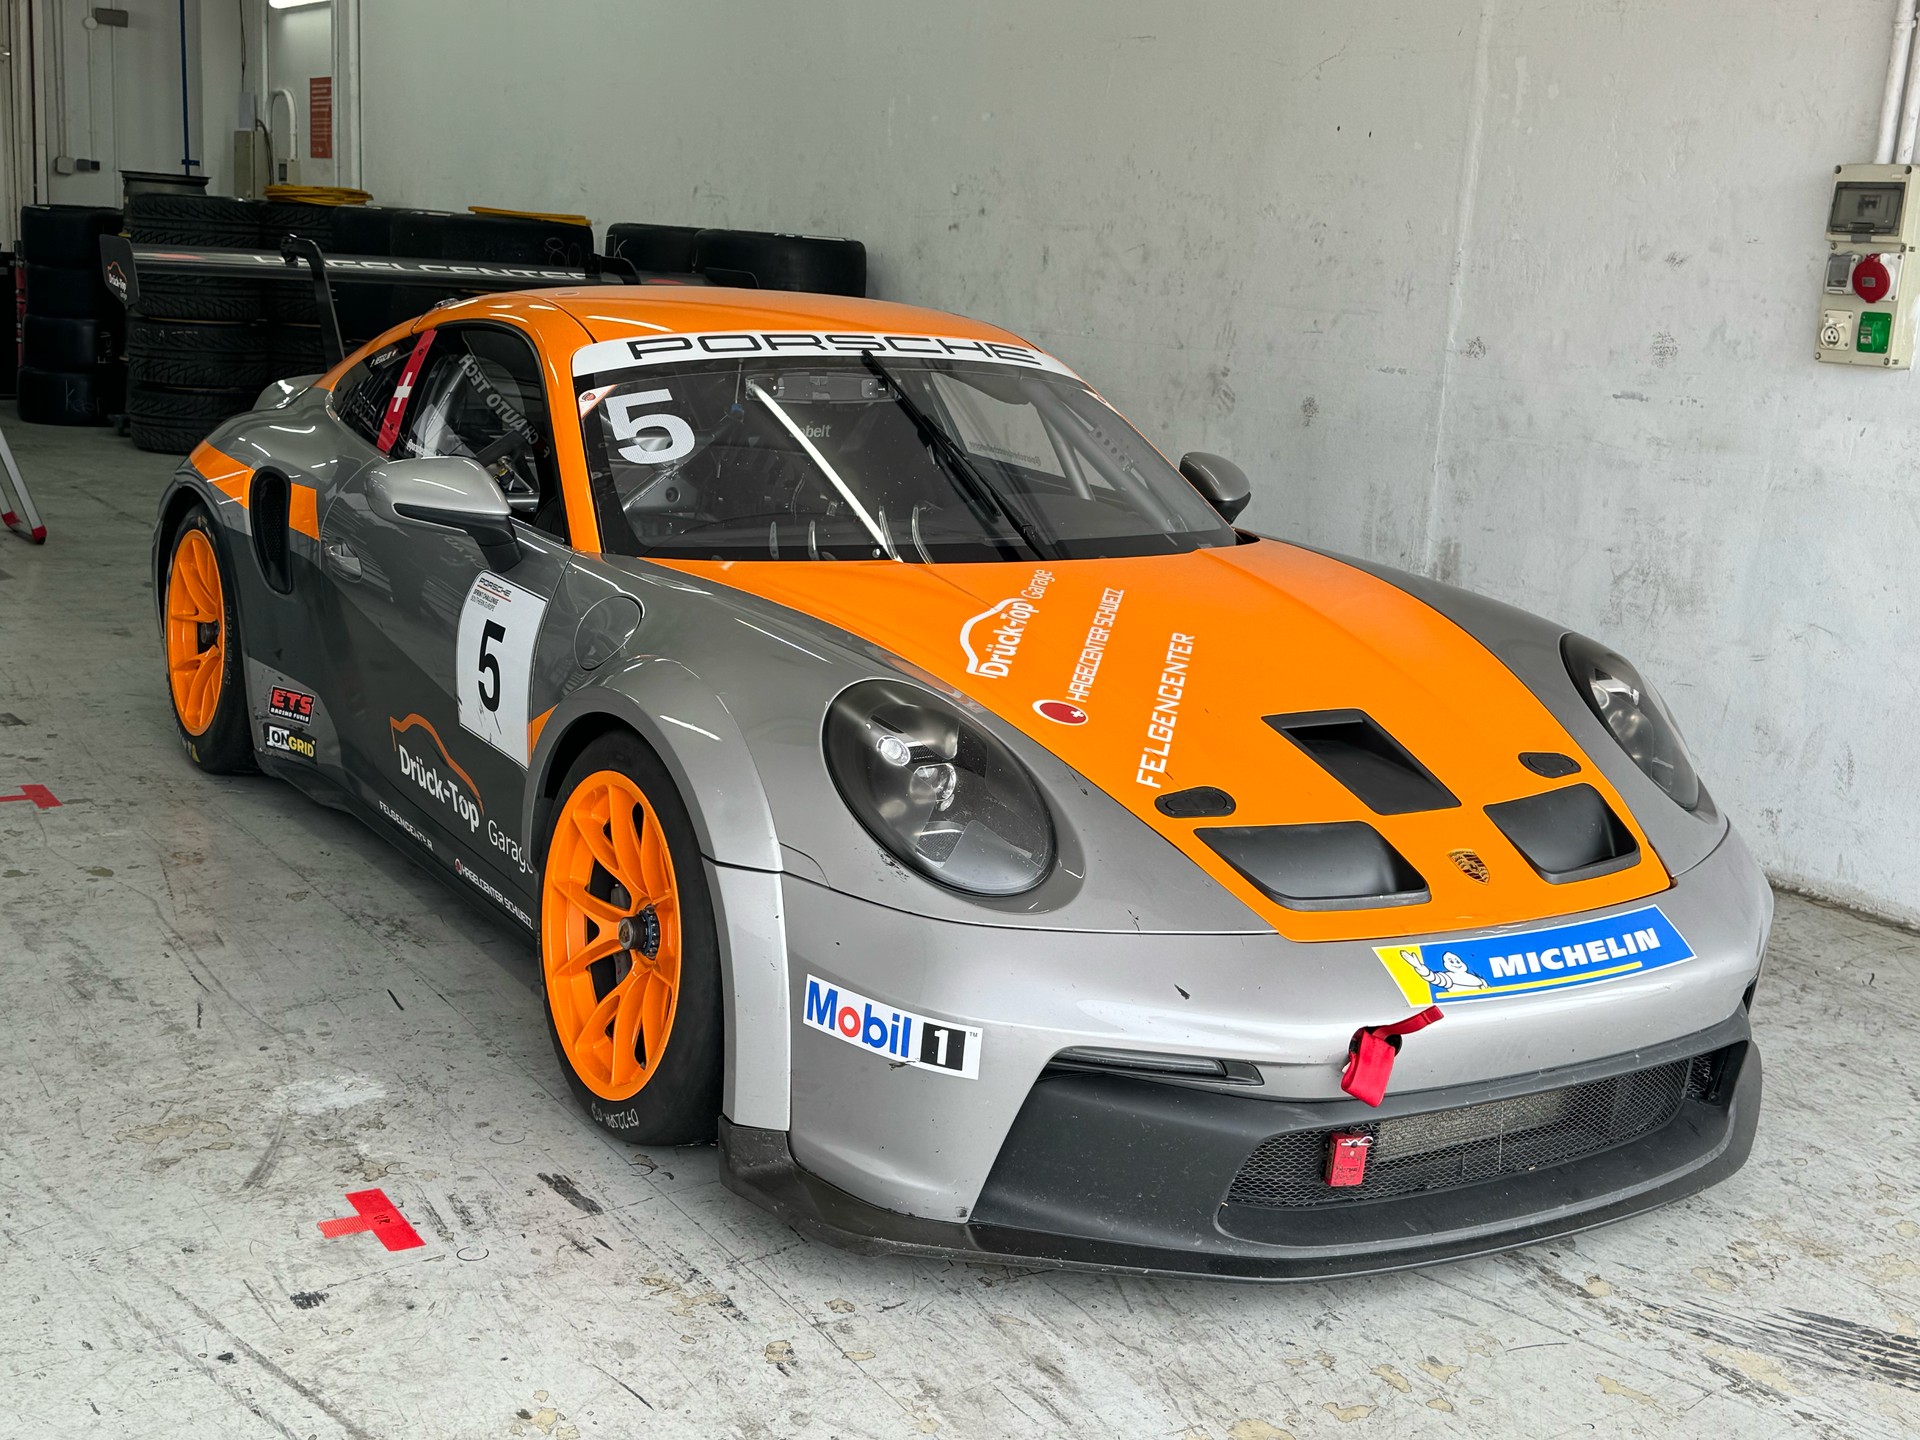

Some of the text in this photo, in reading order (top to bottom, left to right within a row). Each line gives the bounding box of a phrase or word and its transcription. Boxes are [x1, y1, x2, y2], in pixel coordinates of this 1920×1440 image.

[627, 333, 1042, 366] PORSCHE
[605, 388, 696, 465] 5
[479, 577, 512, 597] PORSCHE
[979, 569, 1056, 677] Drück-Top Garage
[478, 618, 506, 713] 5
[1065, 587, 1125, 703] HAGELCENTER SCHWEIZ
[270, 707, 309, 722] RACING FUELS
[272, 689, 313, 715] ETS
[1136, 632, 1195, 790] FELGENCENTER
[398, 744, 480, 833] Drück-Top
[461, 863, 505, 906] HAGELCENTER
[1489, 927, 1662, 979] MICHELIN
[806, 980, 912, 1059] Mobil
